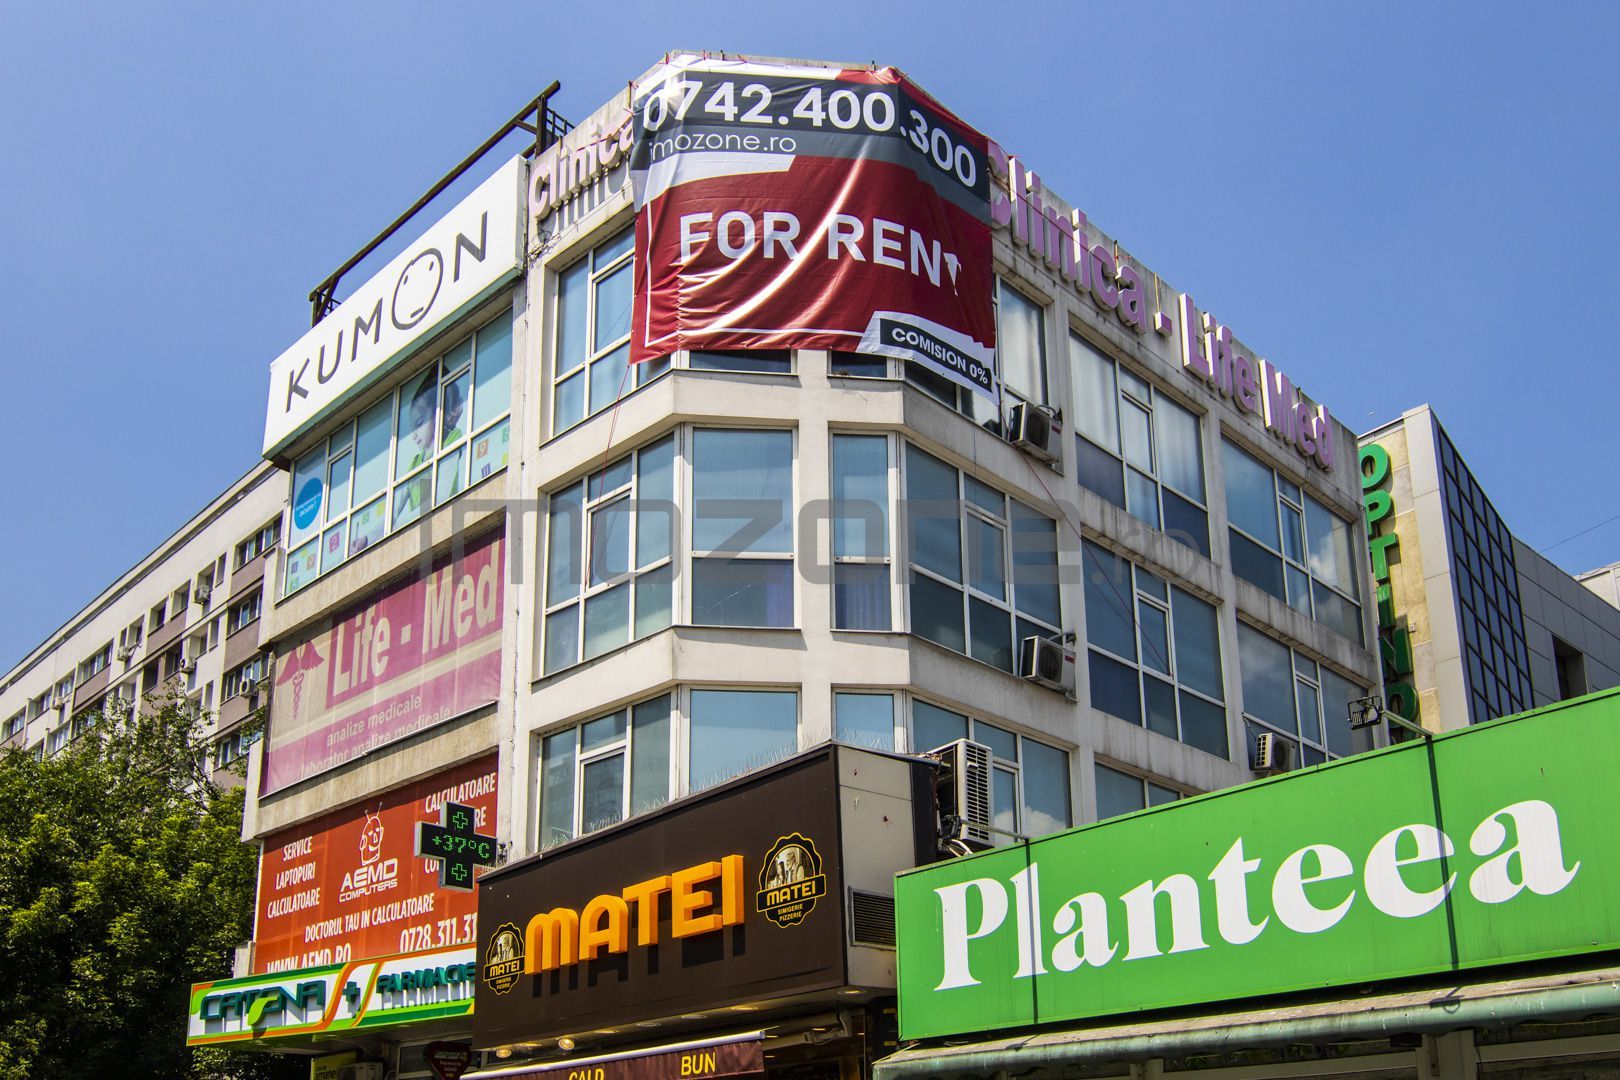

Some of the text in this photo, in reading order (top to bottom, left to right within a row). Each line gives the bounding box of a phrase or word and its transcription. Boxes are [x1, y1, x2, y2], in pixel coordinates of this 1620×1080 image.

[642, 80, 977, 188] 0742.400.300
[648, 130, 797, 161] imozone.ro
[679, 210, 801, 264] FOR
[286, 210, 488, 413] KUMON
[891, 325, 989, 385] COMISION 0%
[1178, 292, 1257, 414] Life
[1258, 358, 1335, 473] Med
[333, 604, 391, 697] Life
[422, 538, 501, 656] Med
[326, 693, 423, 748] analize medicale
[283, 836, 312, 862] SERVICE
[275, 862, 316, 891] LAPTOPURI
[339, 878, 398, 903] COMPUTERS
[340, 857, 398, 892] AEMD
[766, 880, 816, 907] MATEI
[933, 799, 1582, 992] Planteea
[267, 887, 321, 919] CALCULATOARE
[305, 892, 435, 943] DOCTORUL TAU IN CALCULATOARE
[525, 853, 745, 976] MATEI
[376, 961, 477, 994] FARMACIE
[490, 959, 520, 977] MATEI
[681, 1052, 716, 1076] BUN
